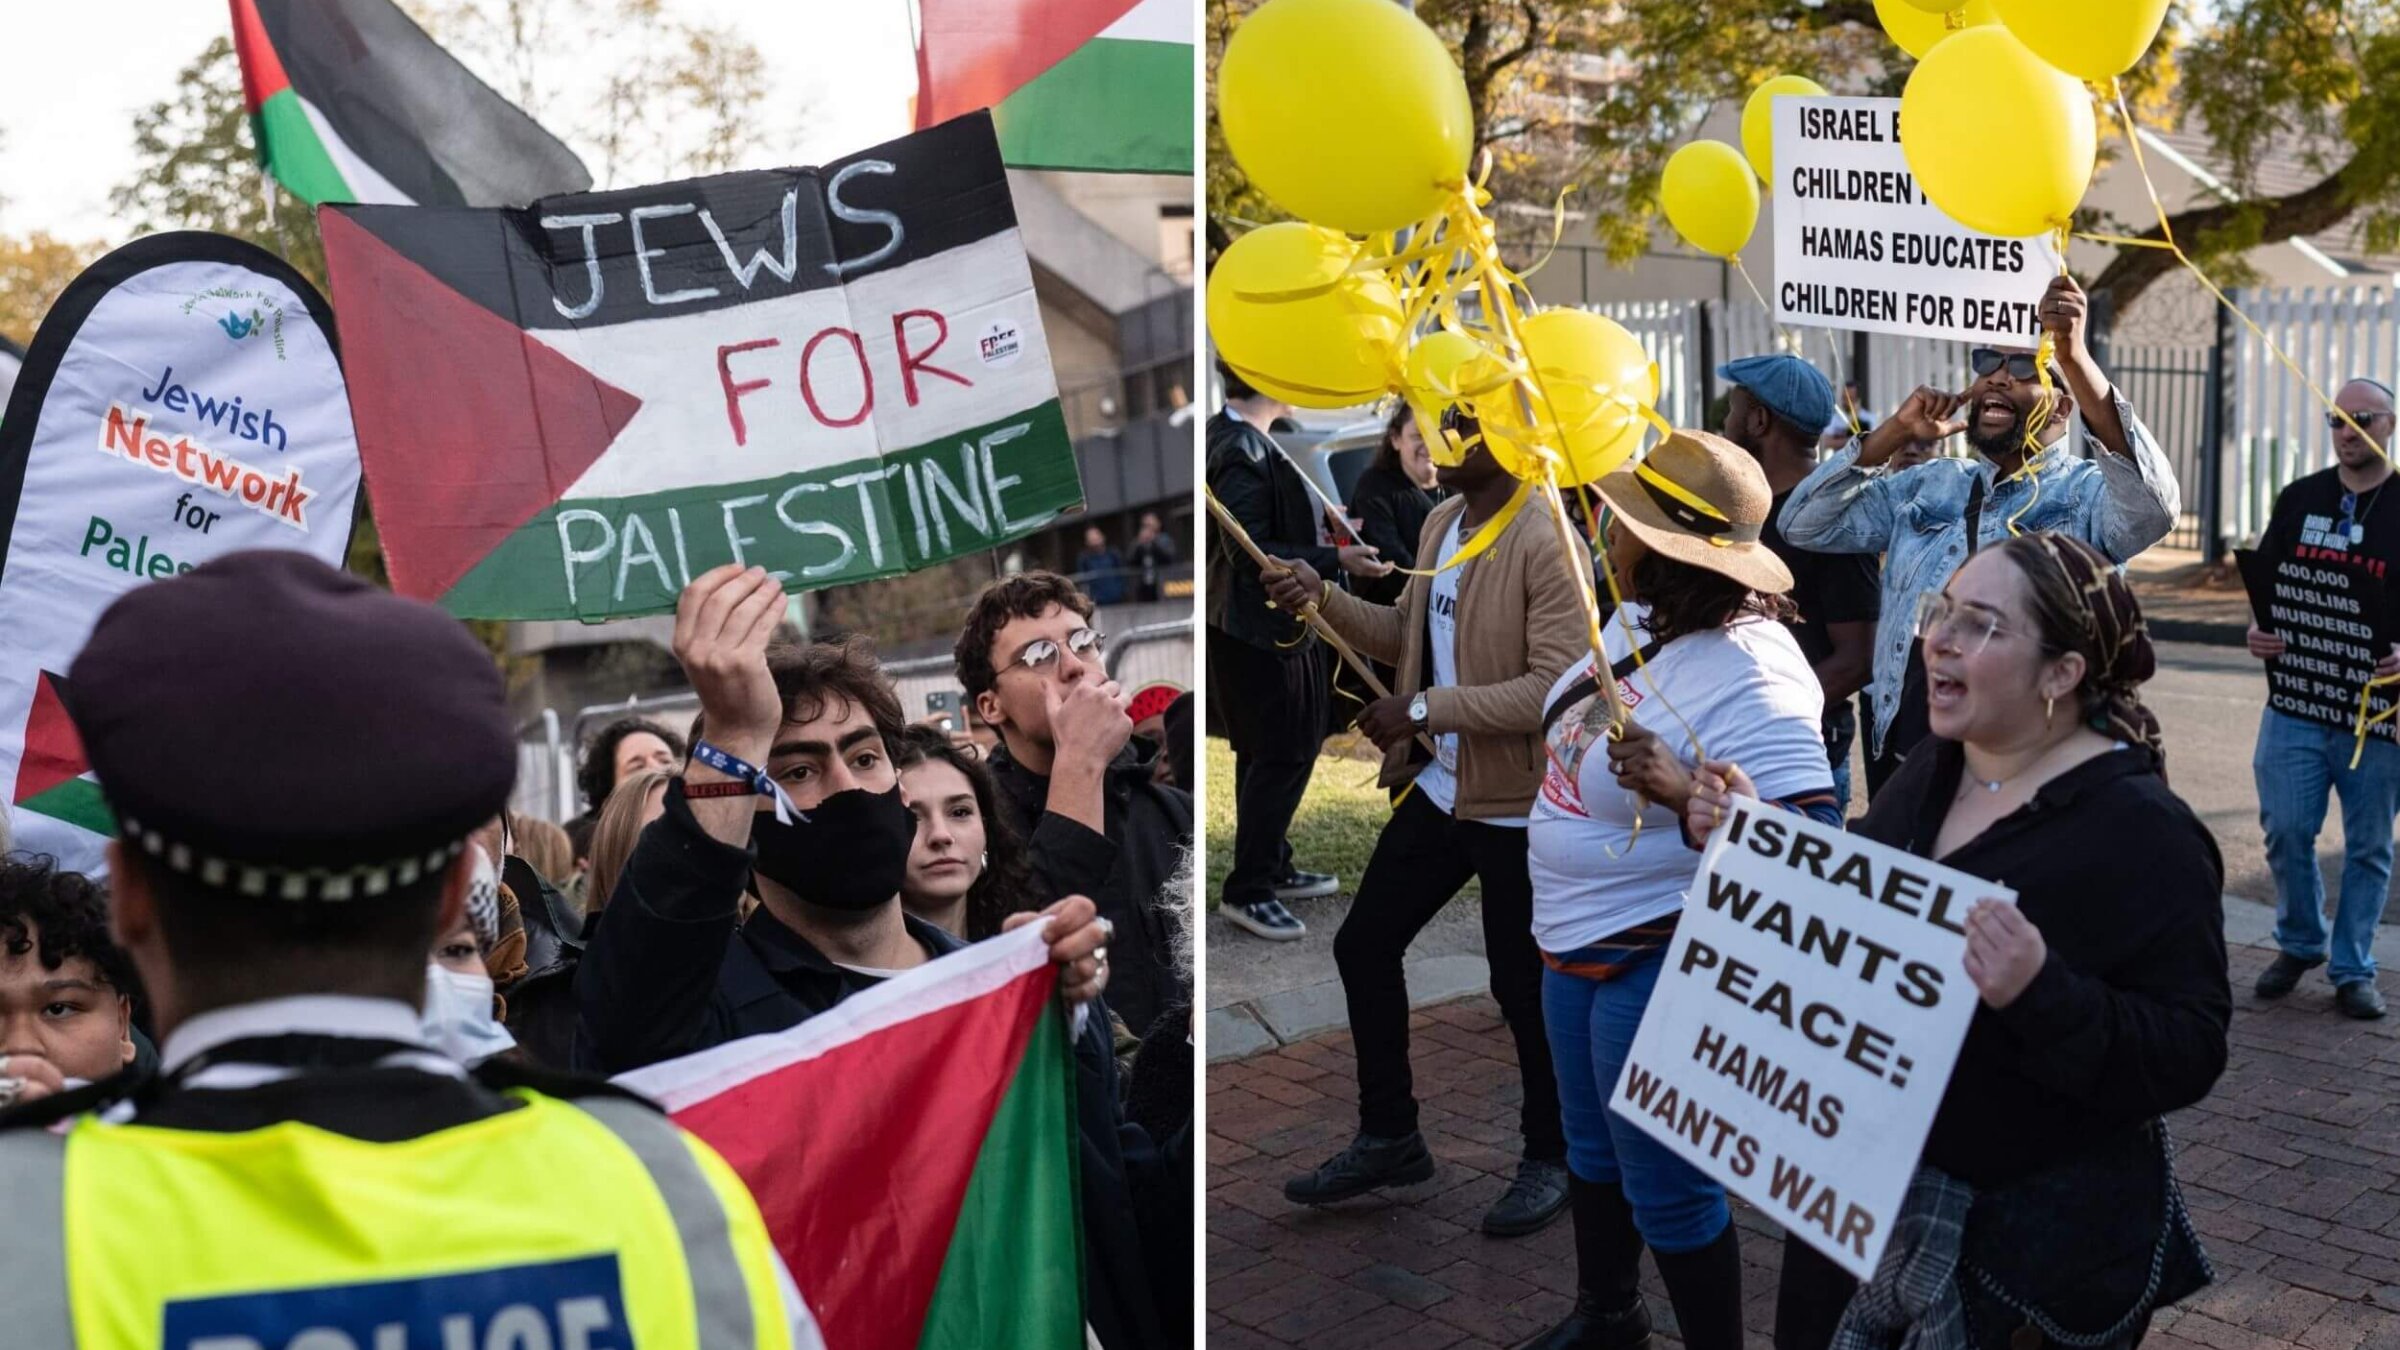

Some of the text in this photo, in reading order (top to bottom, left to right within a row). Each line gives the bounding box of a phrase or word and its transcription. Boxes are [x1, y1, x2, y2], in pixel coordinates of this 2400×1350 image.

[1800, 107, 1884, 143] ISRAEL
[1793, 167, 1912, 205] CHILDREN
[541, 159, 904, 320] JEWS
[1802, 226, 2025, 273] HAMAS EDUCATES
[1781, 282, 1897, 322] CHILDREN
[1906, 294, 1954, 328] FOR
[718, 308, 974, 447] FOR
[143, 366, 287, 452] Jewish
[105, 406, 308, 523] Network
[173, 493, 221, 535] for
[556, 422, 1062, 605] PALESTINE
[2304, 514, 2333, 532] BRING
[2300, 529, 2324, 547] THEM
[2278, 562, 2349, 589] 400,000
[2275, 583, 2360, 614] MUSLIMS
[2271, 604, 2373, 639] MURDERED
[2279, 653, 2341, 678] WHERE
[2299, 633, 2377, 667] DARFUR,
[2272, 694, 2342, 722] COSATU
[2273, 671, 2309, 692] THE
[2312, 681, 2349, 702] PSC
[1727, 809, 1967, 936] ISRAEL
[1706, 873, 1945, 1008] WANTS
[1679, 938, 1914, 1088] PEACE:
[1692, 1025, 1844, 1139] HAMAS
[1623, 1063, 1875, 1258] WANTS WAR
